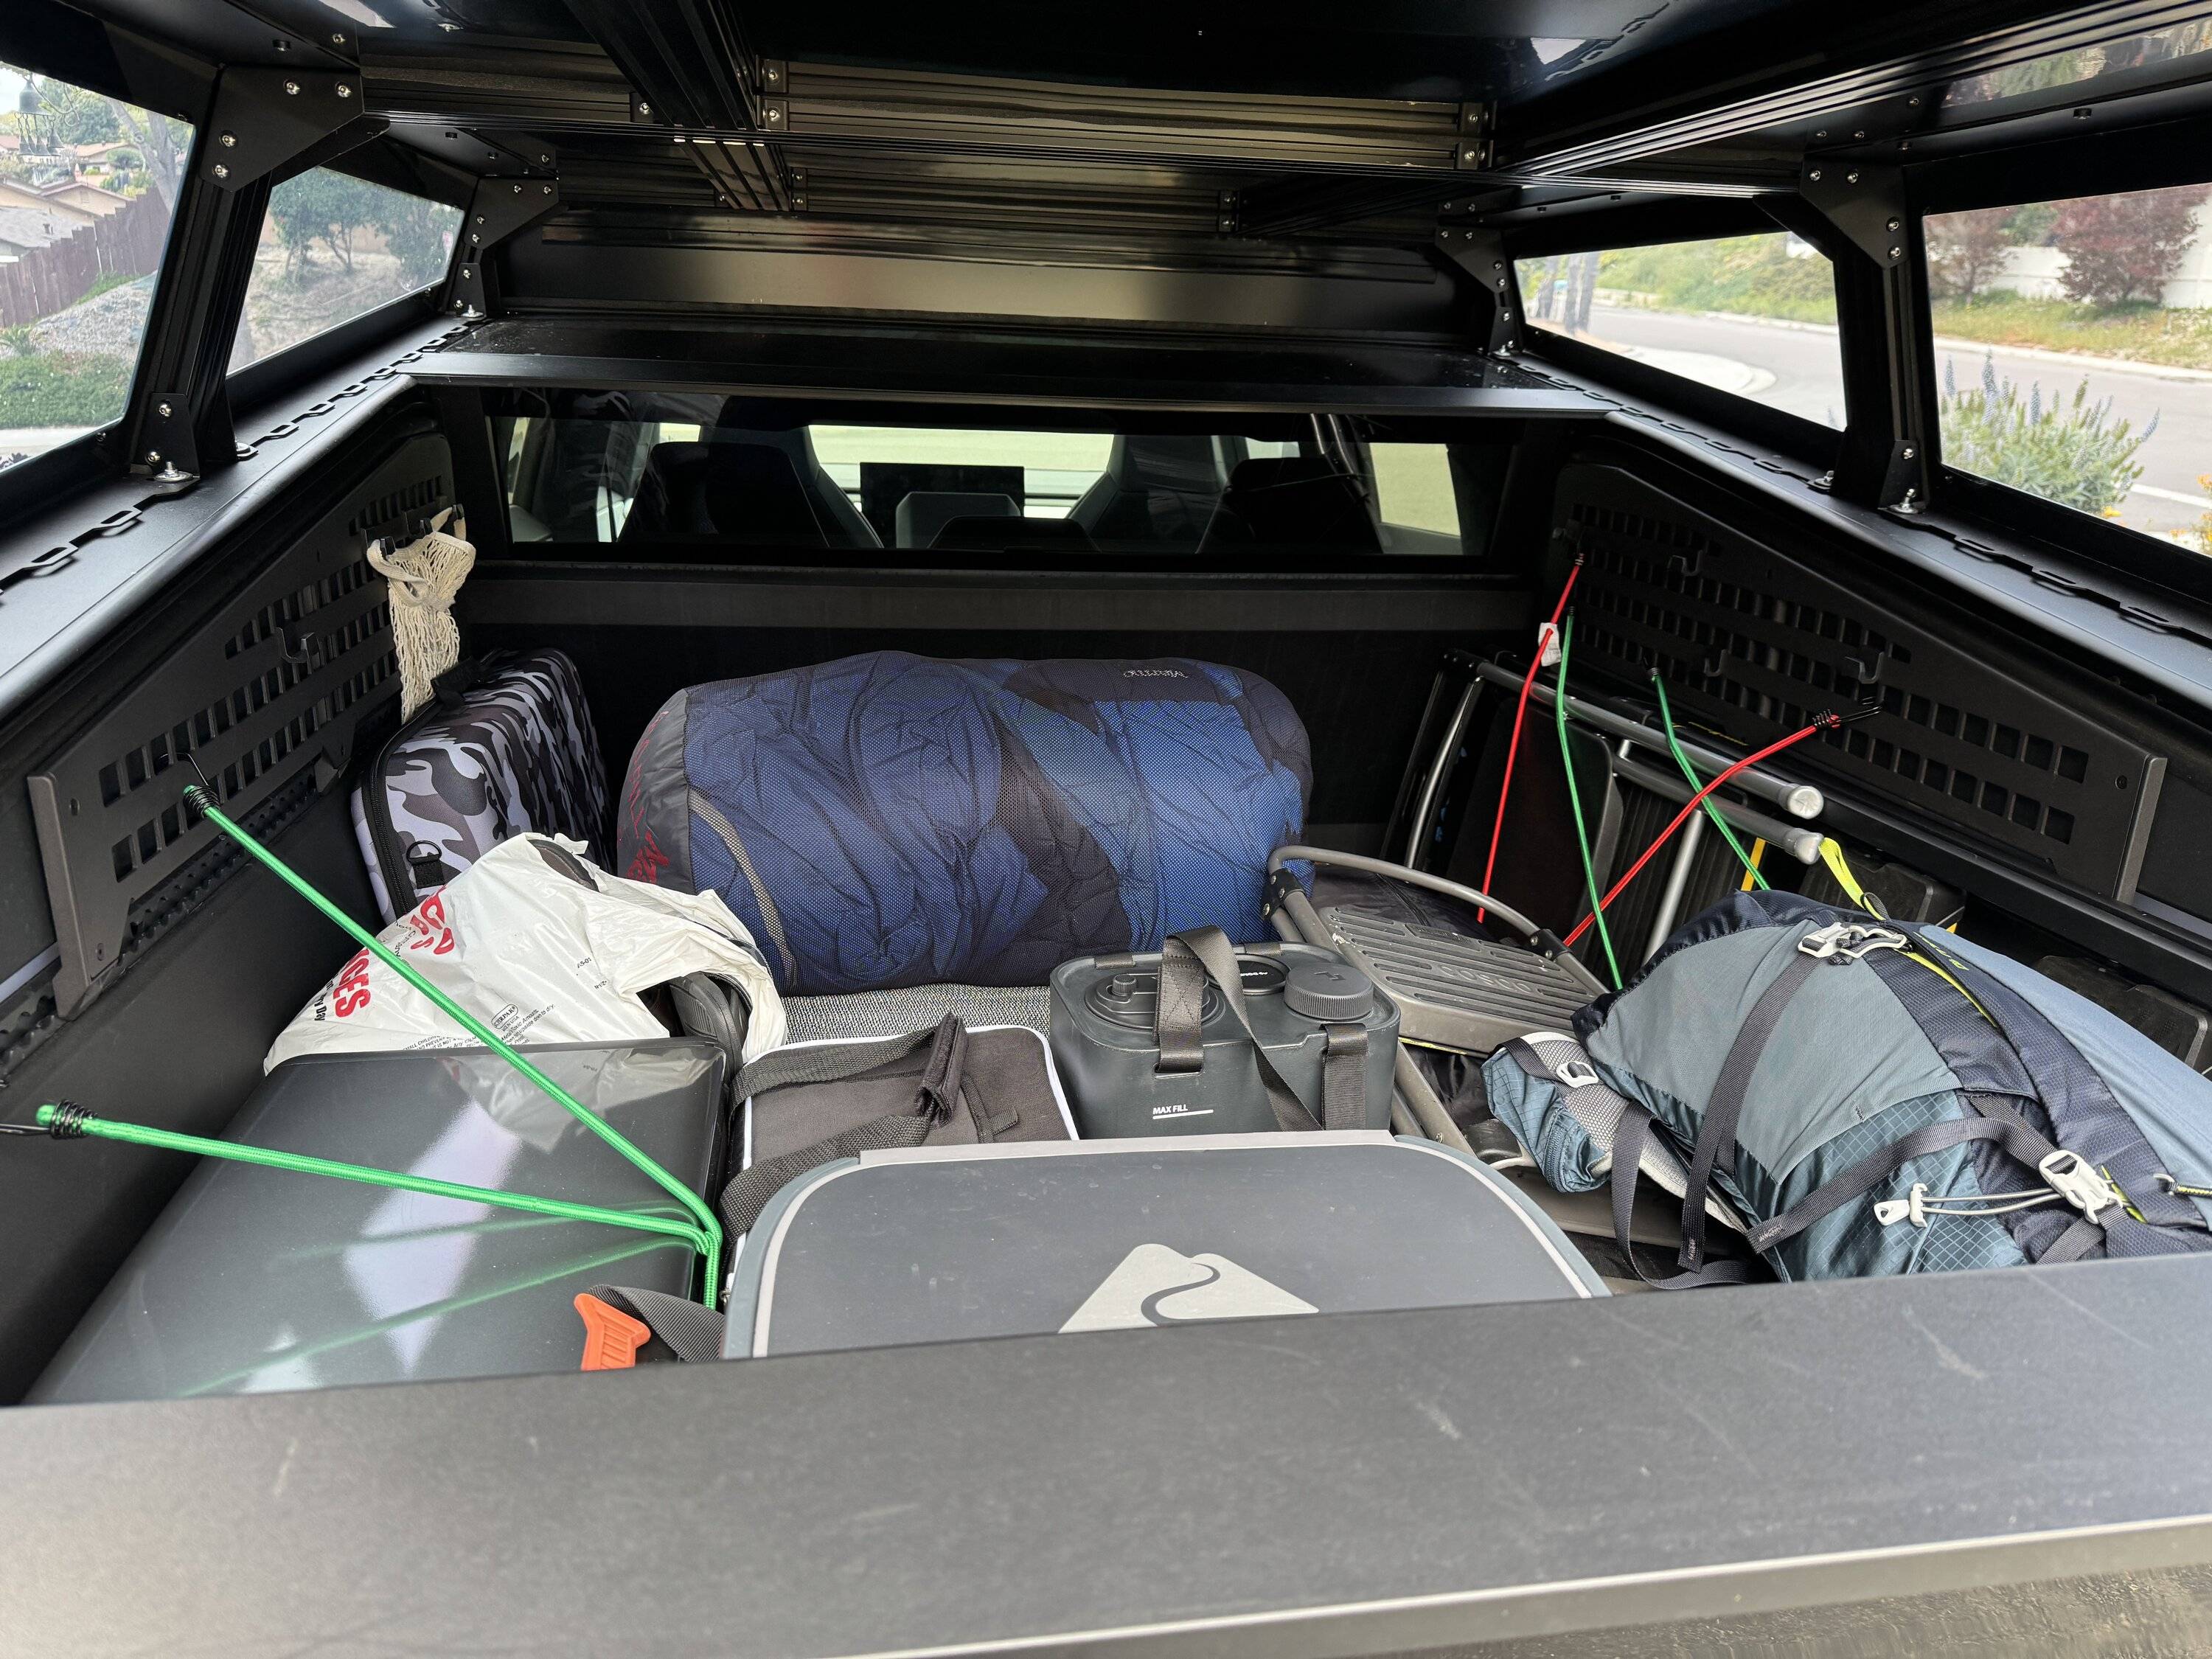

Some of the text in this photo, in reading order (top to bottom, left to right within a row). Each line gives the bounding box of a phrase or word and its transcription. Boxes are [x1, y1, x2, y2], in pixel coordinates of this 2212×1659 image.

[333, 947, 371, 1018] ICES
[1439, 964, 1533, 994] COSCO
[314, 1005, 327, 1021] Day
[1152, 1104, 1189, 1115] MAX FILL
